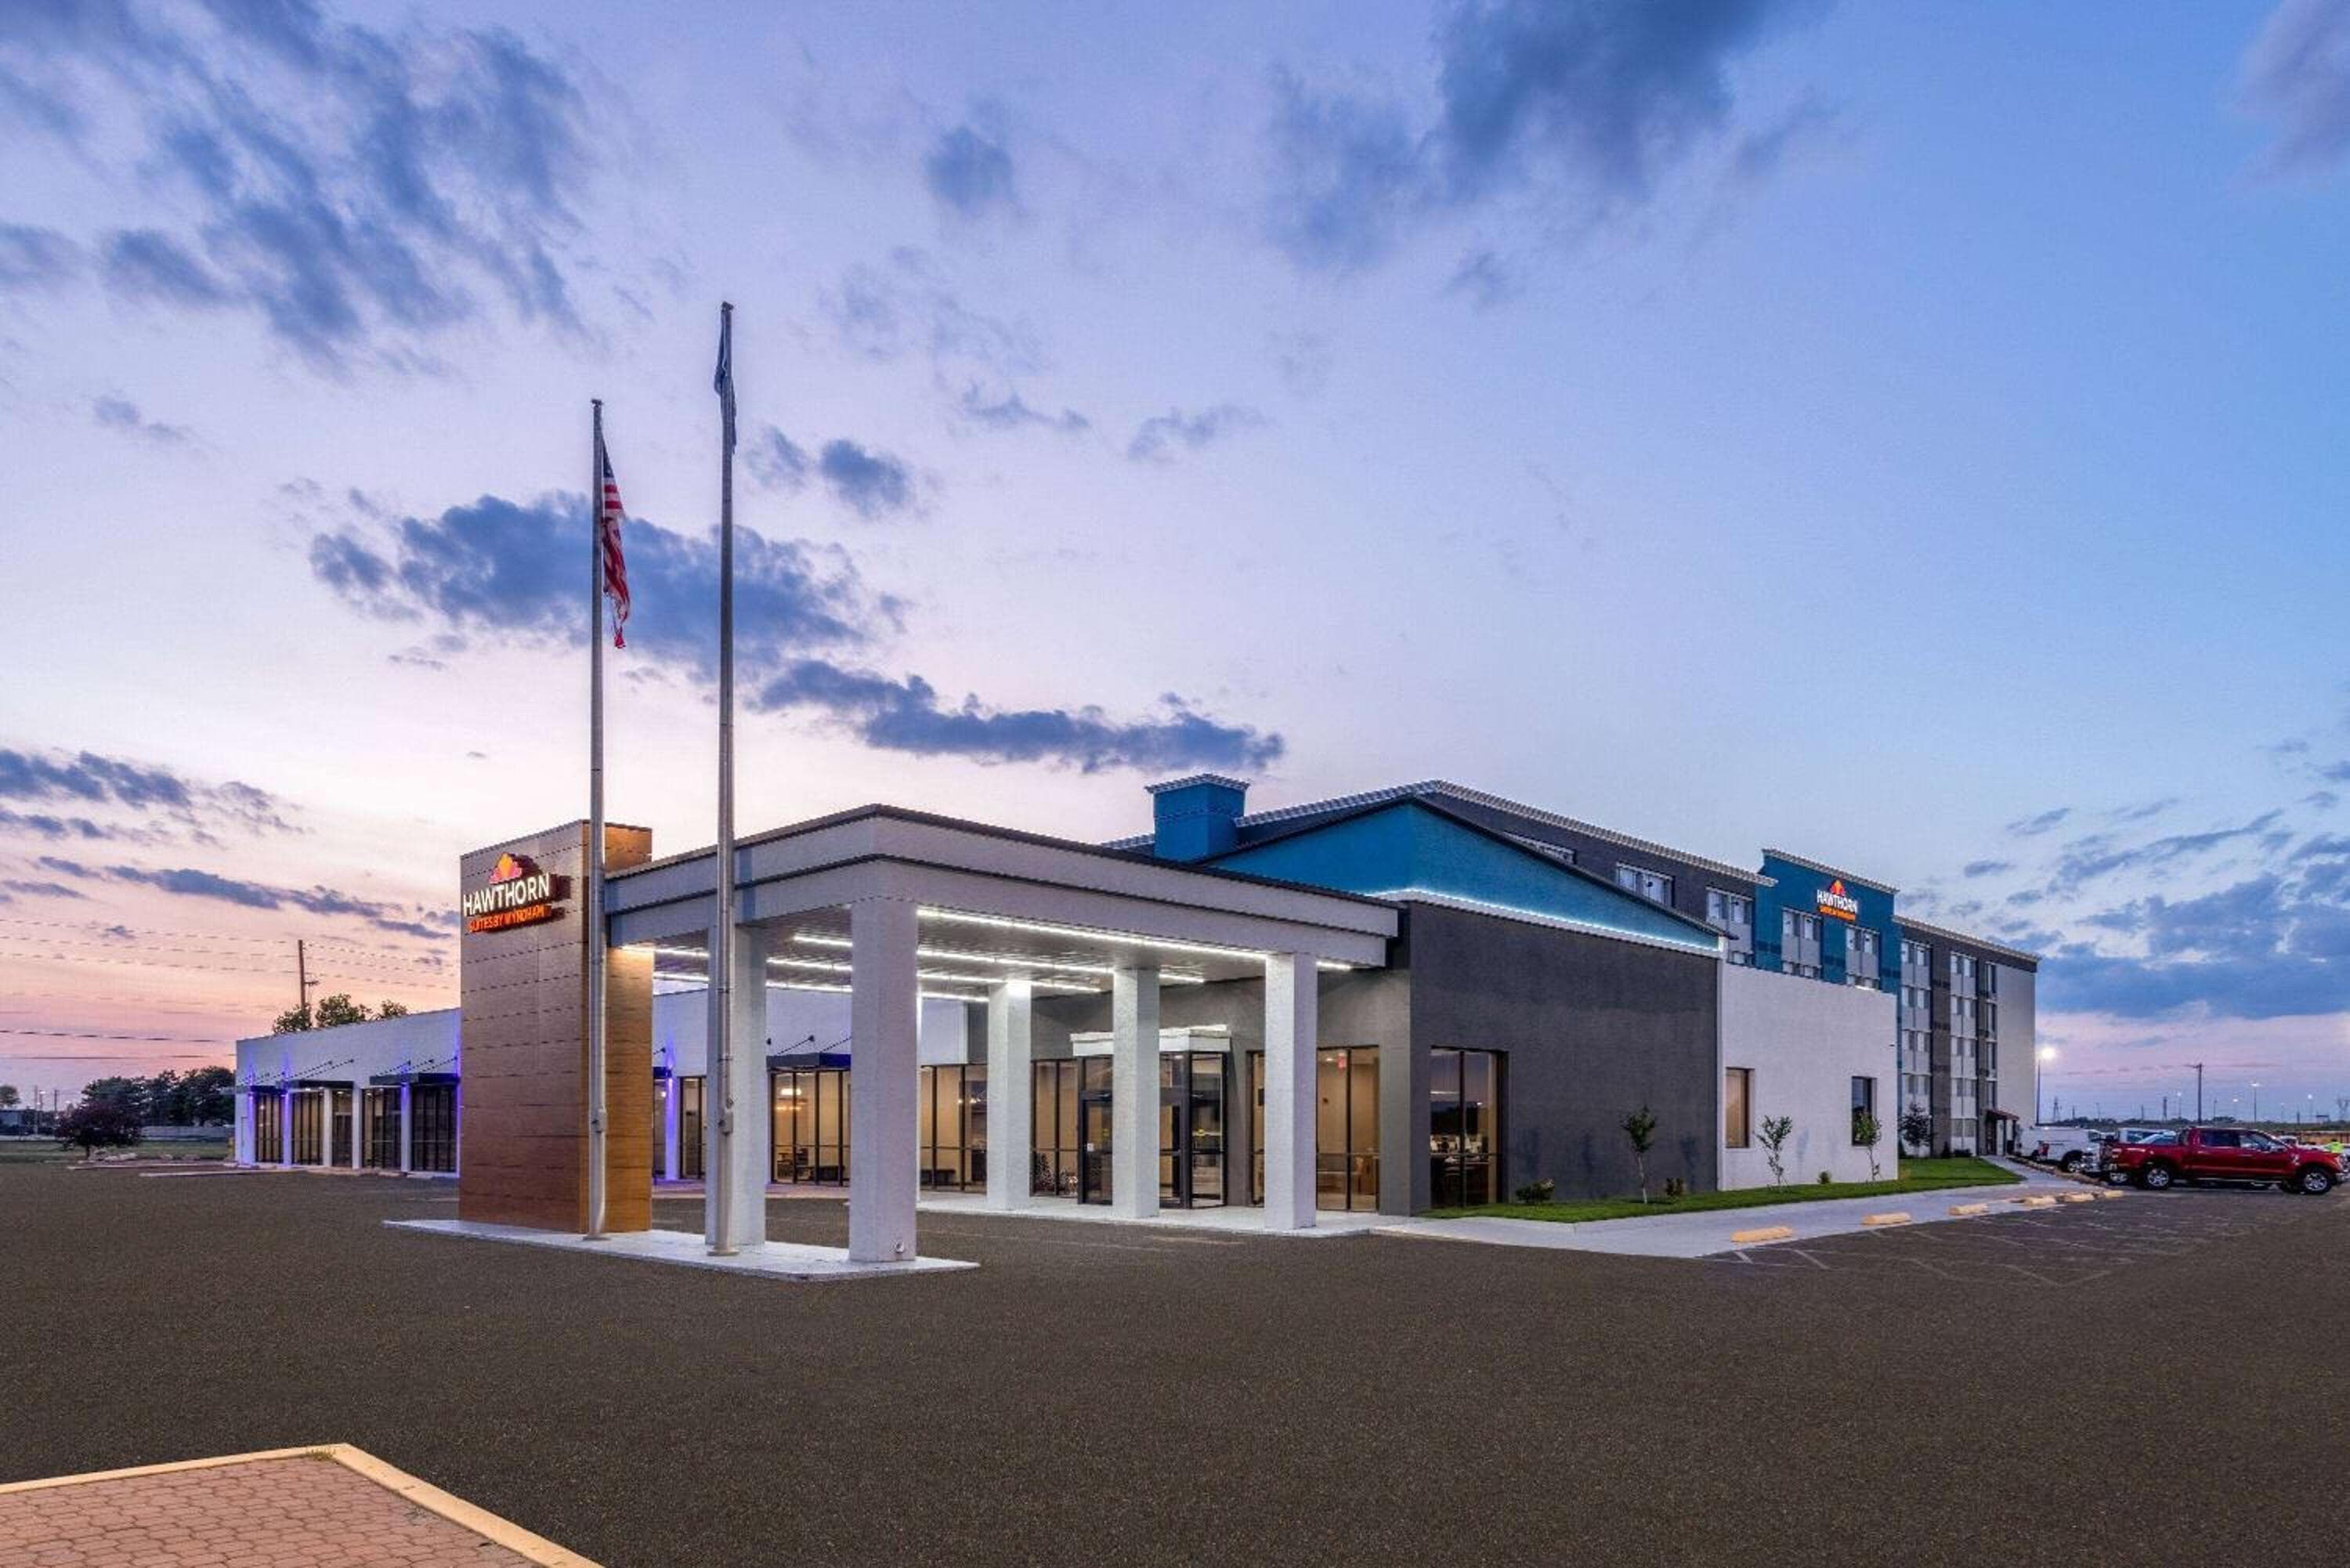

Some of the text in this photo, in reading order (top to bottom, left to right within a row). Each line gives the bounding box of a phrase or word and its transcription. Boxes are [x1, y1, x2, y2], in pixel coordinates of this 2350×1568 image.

[463, 873, 550, 917] HAWTHORN
[468, 916, 493, 933] SUITES
[494, 915, 503, 927] BY
